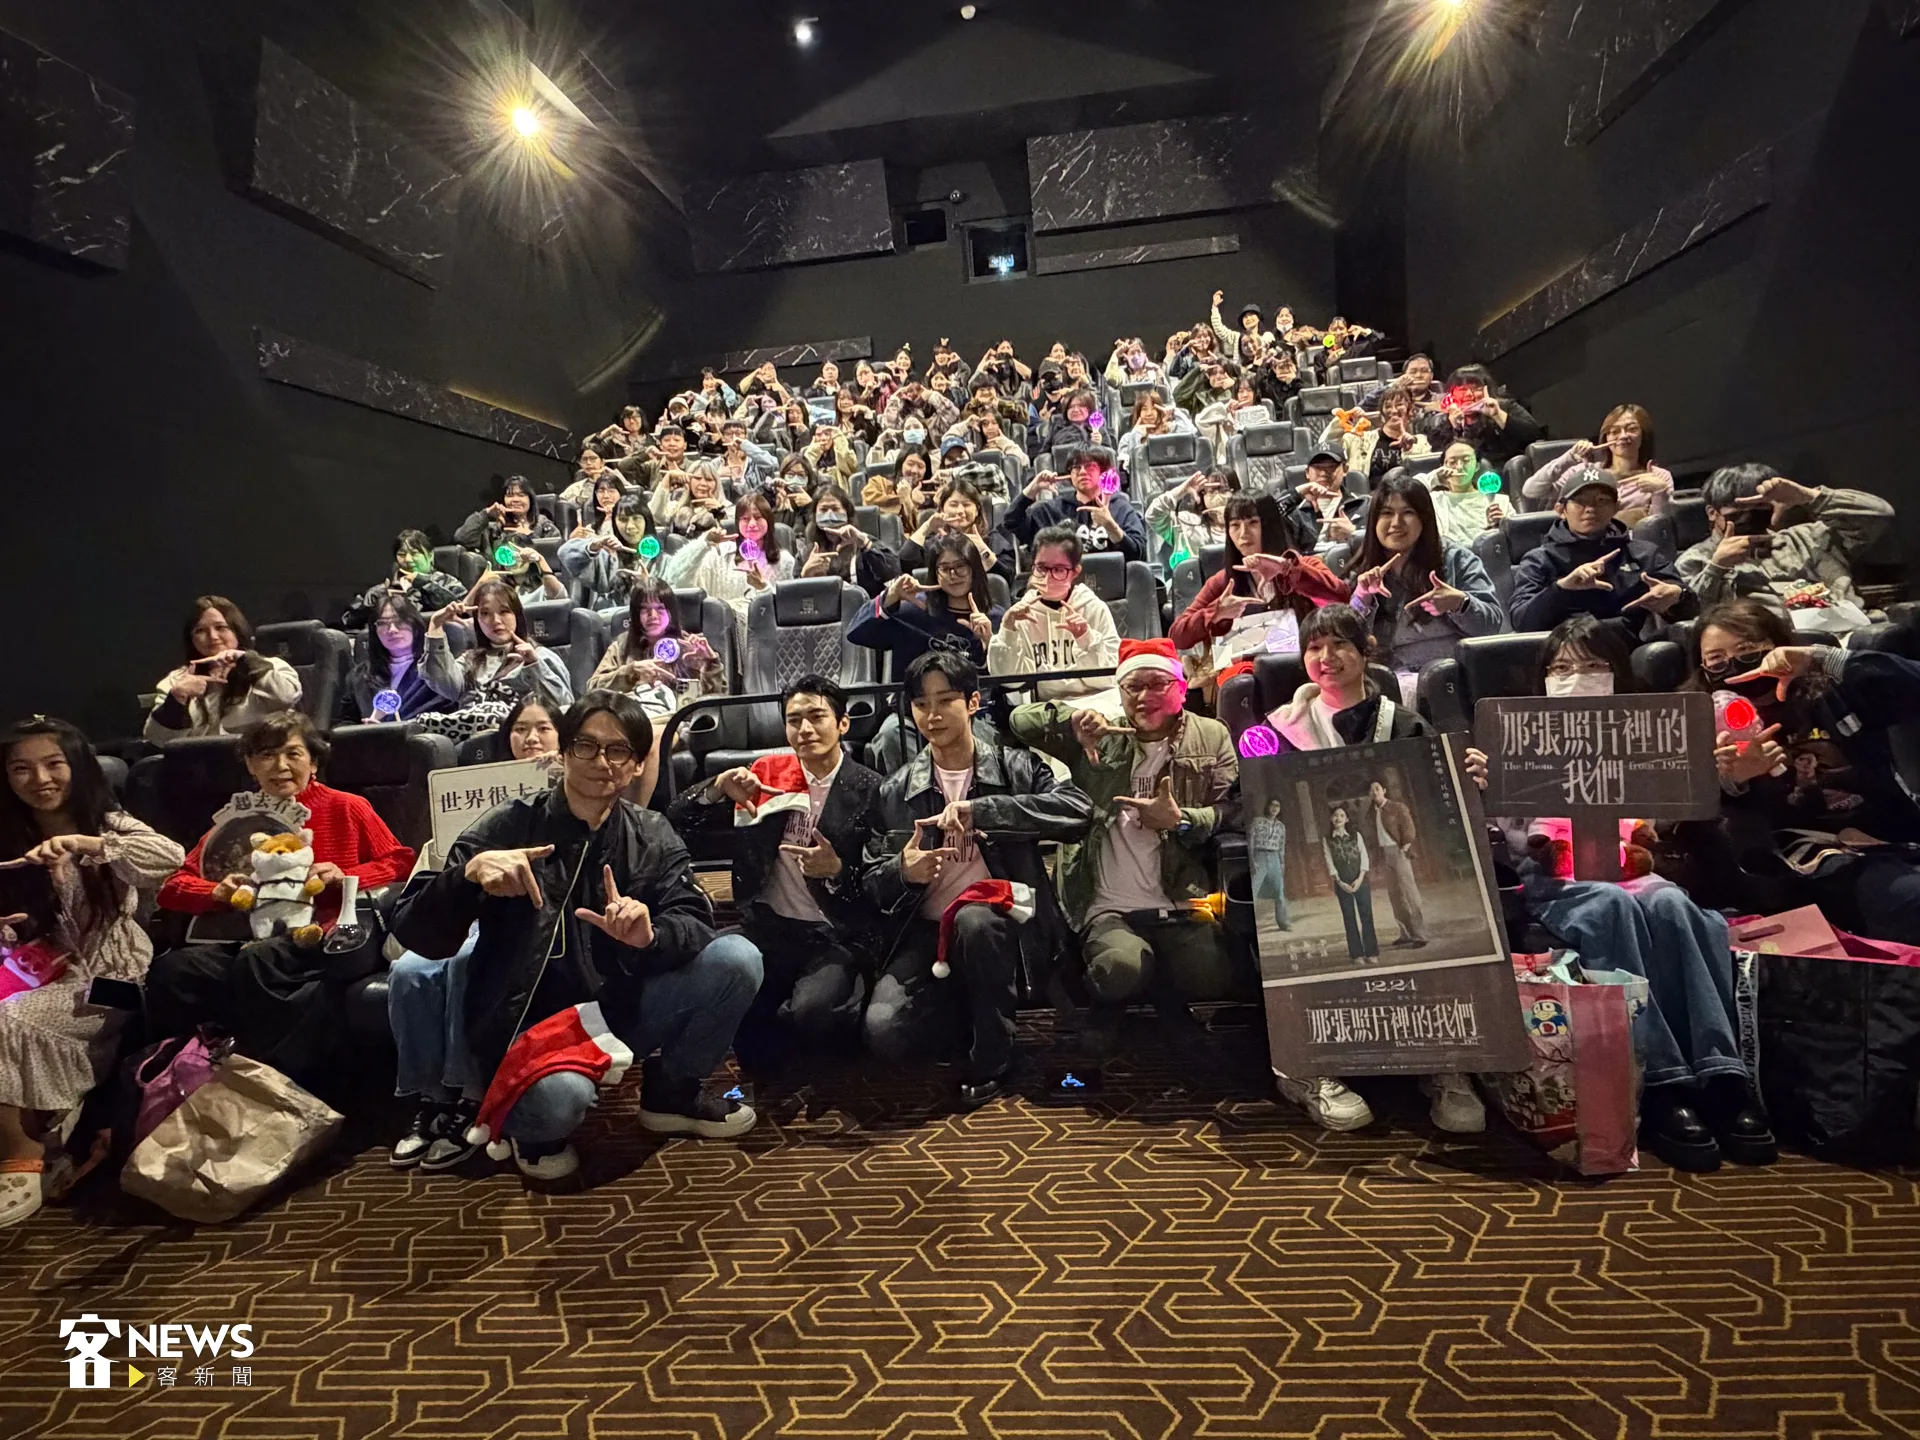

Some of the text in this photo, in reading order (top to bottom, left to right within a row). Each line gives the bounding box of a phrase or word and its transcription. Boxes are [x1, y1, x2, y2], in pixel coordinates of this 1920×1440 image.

[1338, 558, 1345, 568] 3
[1187, 570, 1194, 580] 4
[622, 619, 630, 628] 8
[1447, 682, 1455, 694] 3
[1241, 696, 1249, 708] 4
[1501, 708, 1688, 756] 那張照片裡的
[475, 749, 484, 760] 8
[1562, 755, 1625, 805] 我們
[1311, 998, 1478, 1043] 那張照片裡的我們
